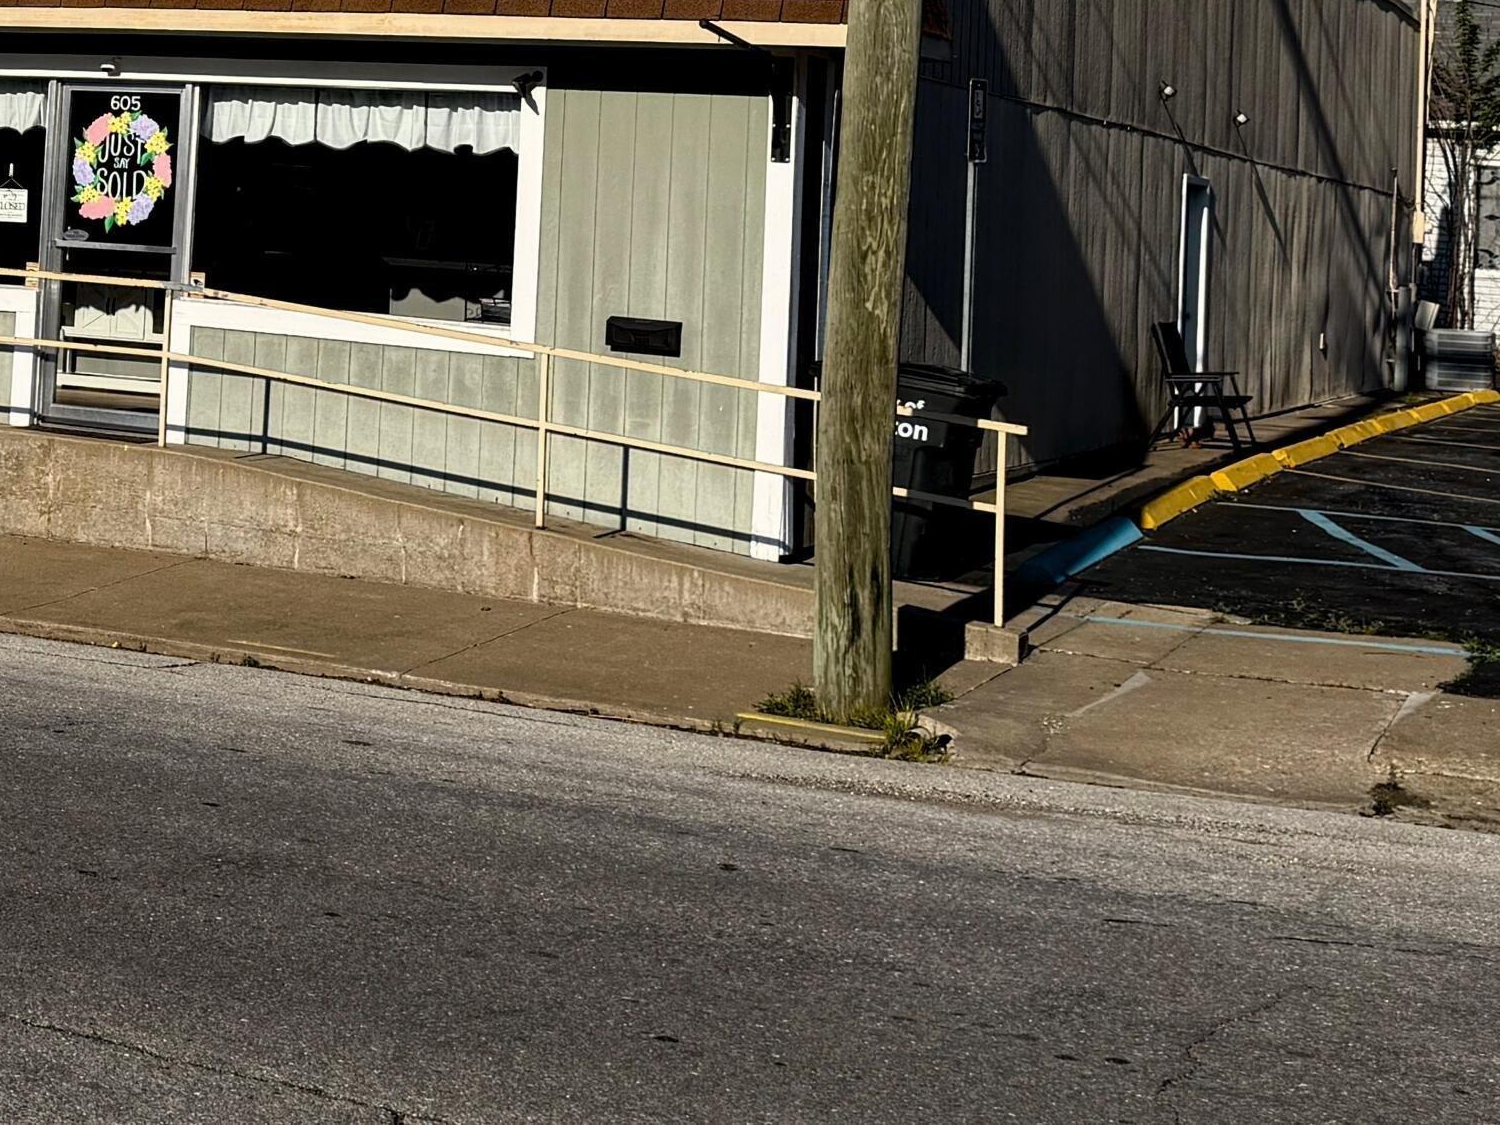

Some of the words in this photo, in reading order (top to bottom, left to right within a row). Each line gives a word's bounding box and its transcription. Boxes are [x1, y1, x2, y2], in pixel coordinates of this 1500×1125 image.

[110, 95, 141, 111] 605
[98, 128, 145, 165] JUST
[113, 156, 131, 169] SAY
[96, 167, 147, 201] SOLD
